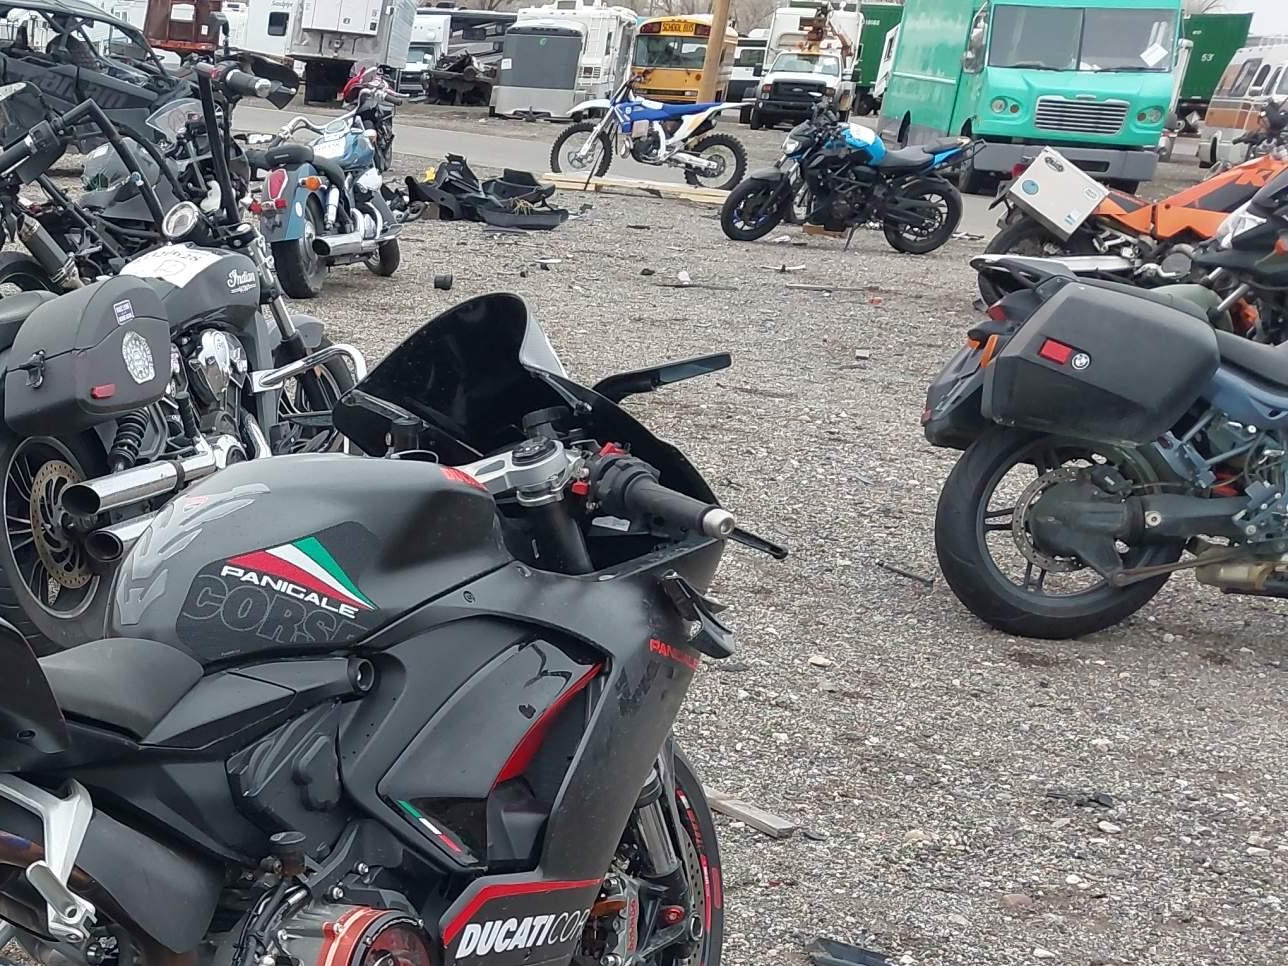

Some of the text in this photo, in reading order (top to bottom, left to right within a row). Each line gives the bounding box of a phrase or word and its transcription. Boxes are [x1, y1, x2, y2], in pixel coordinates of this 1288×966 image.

[662, 23, 694, 33] SCHOOL BUS
[227, 269, 256, 288] Indian
[221, 565, 359, 619] PANIGALE
